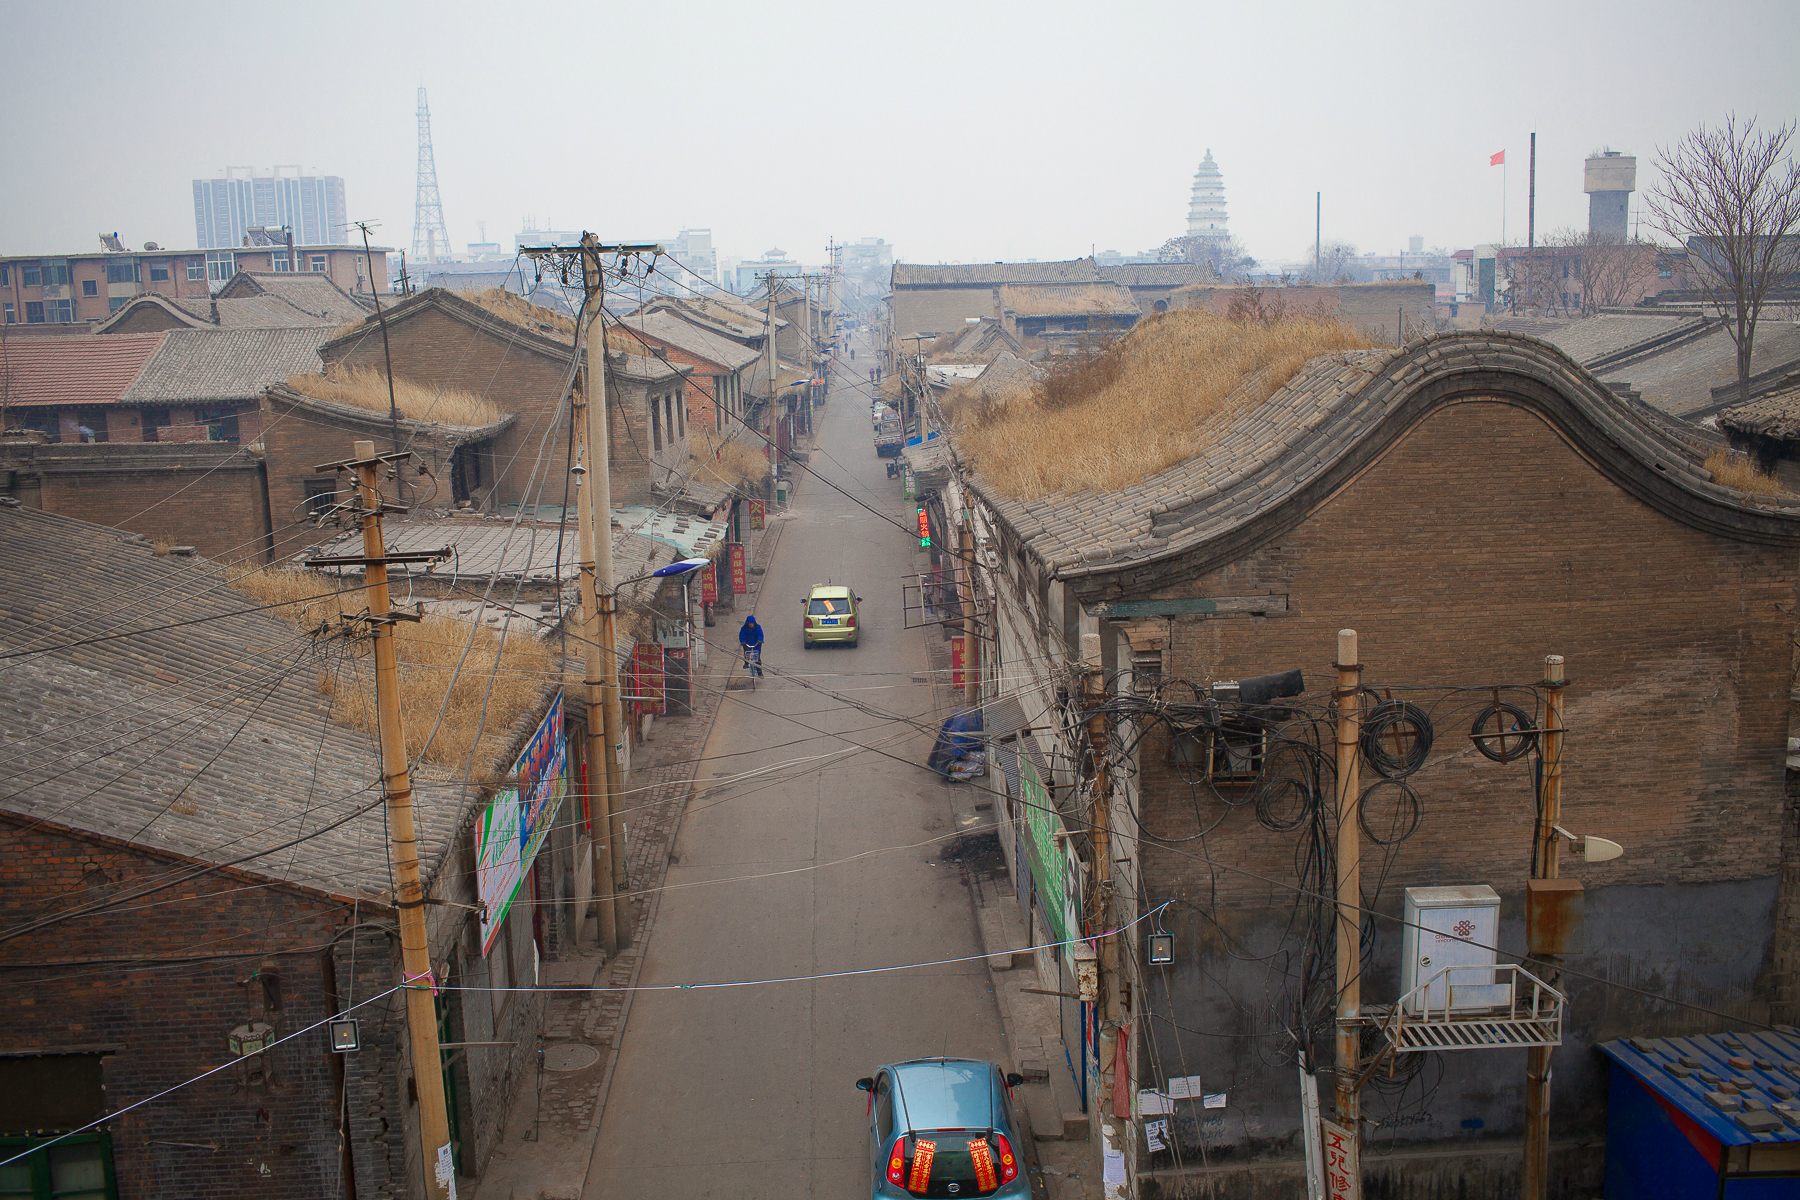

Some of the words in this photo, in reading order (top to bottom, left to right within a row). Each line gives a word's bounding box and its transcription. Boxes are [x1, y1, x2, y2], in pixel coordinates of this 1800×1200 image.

[751, 503, 763, 529] 火锅
[733, 551, 744, 584] 香酥鸡鸭
